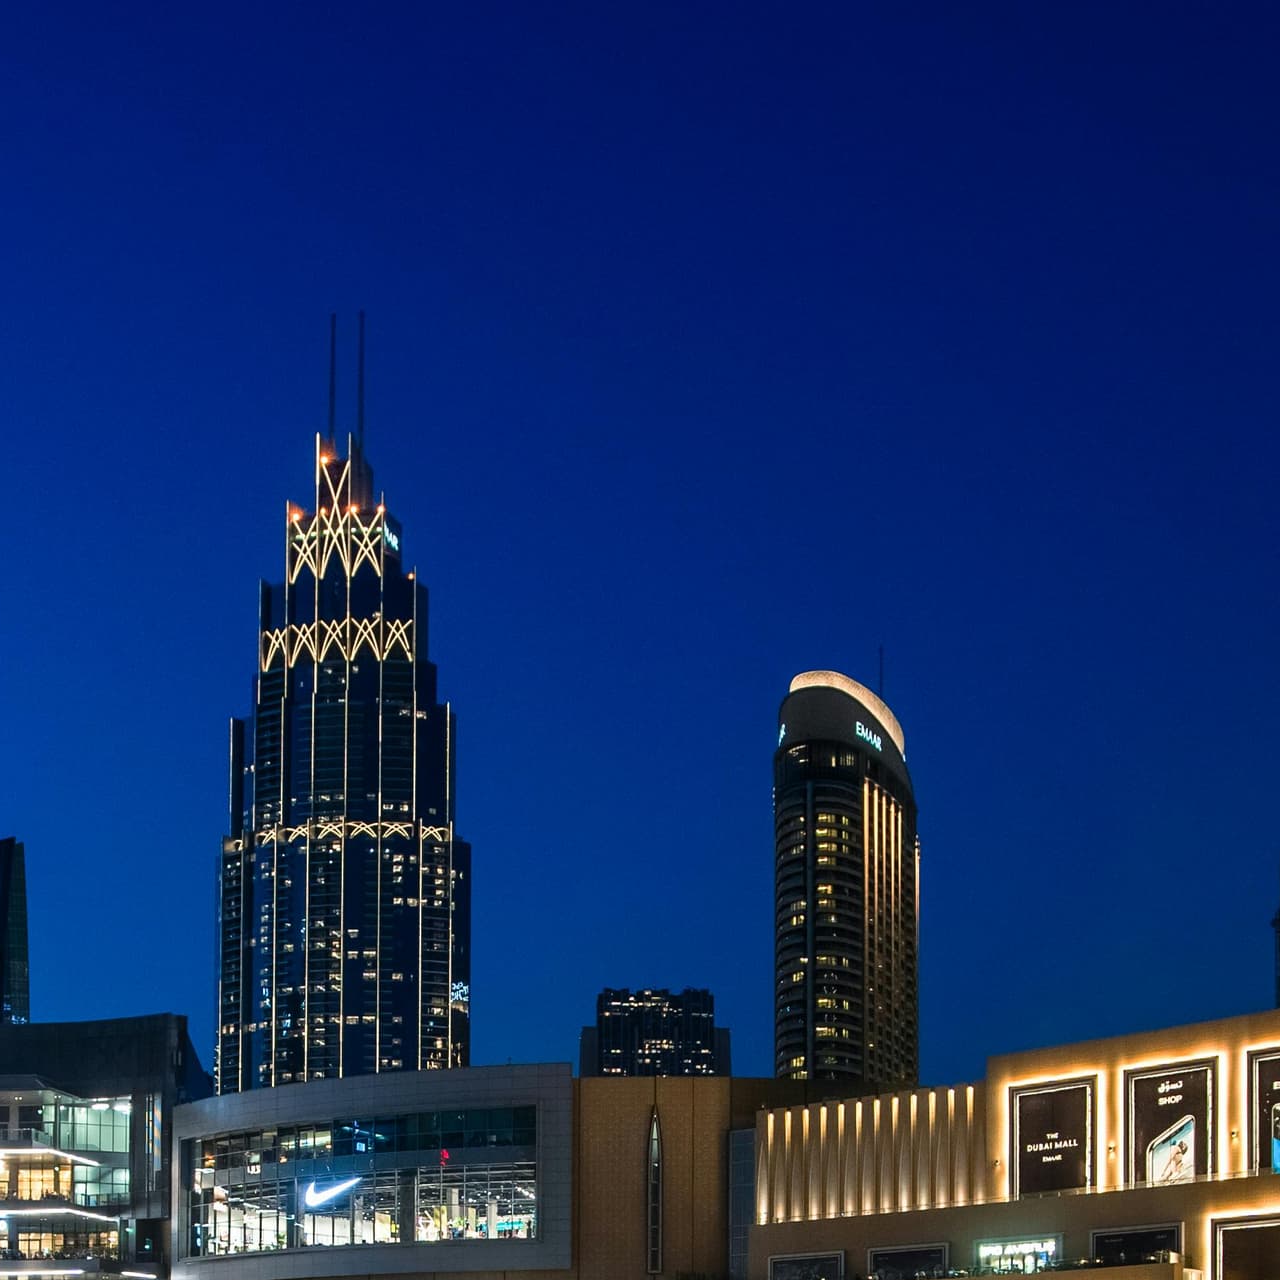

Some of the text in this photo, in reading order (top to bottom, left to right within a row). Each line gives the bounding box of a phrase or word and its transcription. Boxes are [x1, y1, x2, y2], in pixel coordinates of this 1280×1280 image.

[856, 721, 883, 751] EMAAR
[1158, 1094, 1182, 1105] SHOP
[1027, 1139, 1078, 1152] DUBAI MALL
